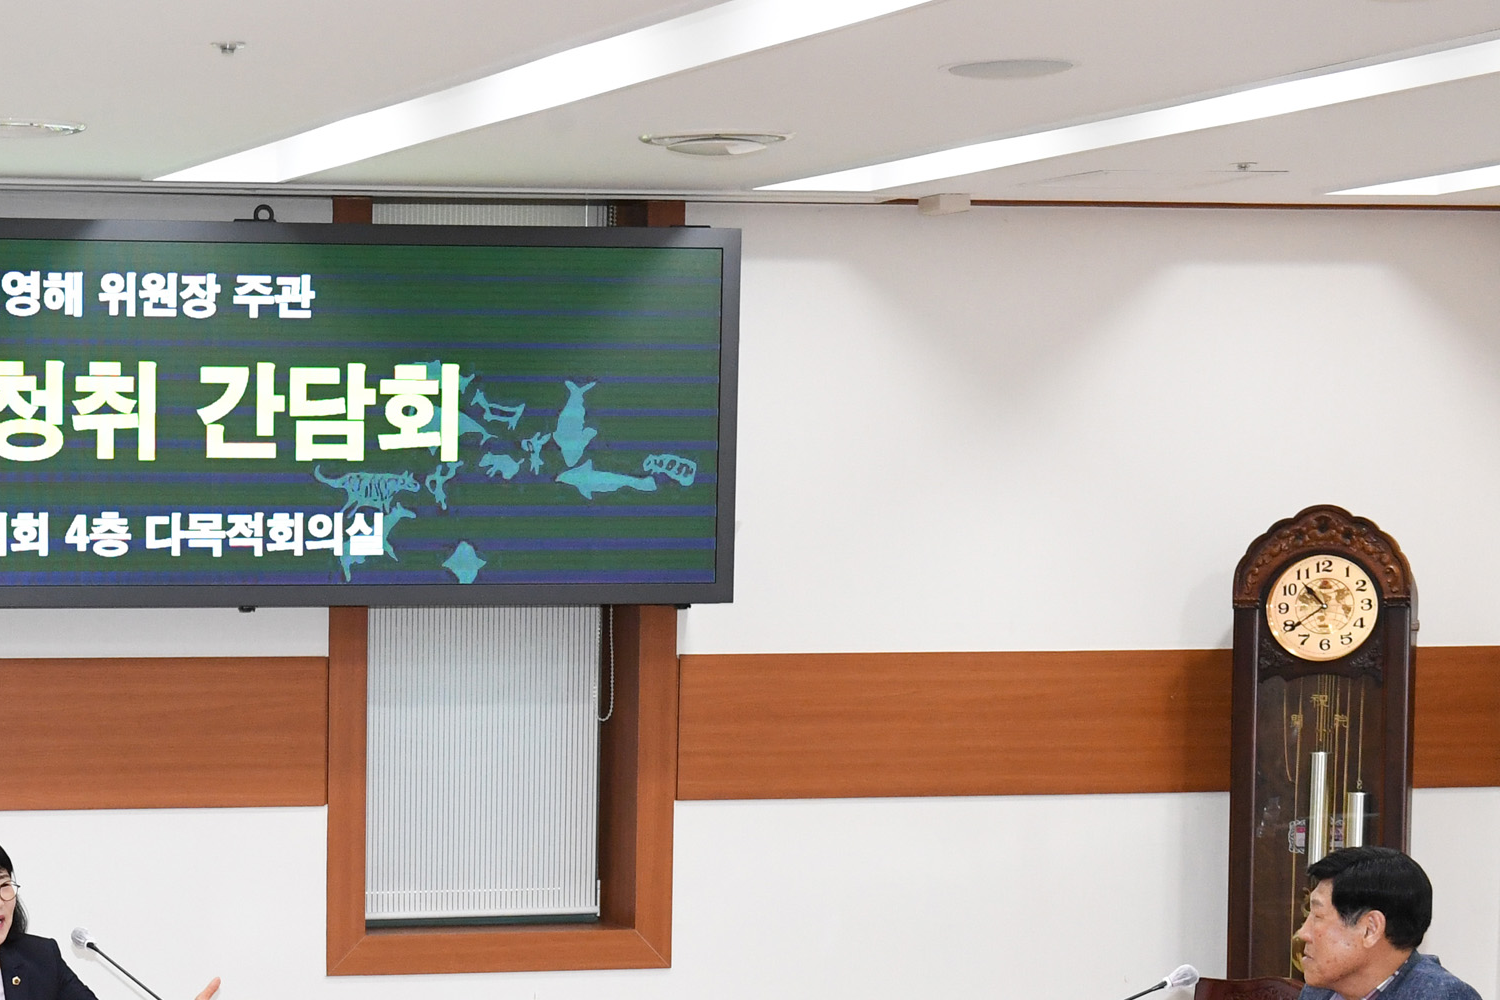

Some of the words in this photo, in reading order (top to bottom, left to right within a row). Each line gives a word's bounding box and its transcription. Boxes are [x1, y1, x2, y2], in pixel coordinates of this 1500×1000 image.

[99, 271, 221, 319] 위원장
[233, 274, 315, 319] 주관
[196, 362, 460, 462] 간담회
[64, 511, 132, 558] 4층
[145, 511, 384, 558] 다목적회의실
[1316, 560, 1333, 573] 12
[1345, 566, 1350, 577] 1
[1296, 567, 1310, 580] 11
[1283, 583, 1297, 596] 10
[1355, 580, 1367, 592] 2
[1278, 602, 1289, 614] 9
[1360, 598, 1373, 611] 3
[1283, 619, 1296, 632] 8
[1353, 617, 1365, 629] 4
[1298, 634, 1310, 646] 7
[1319, 639, 1331, 651] 6
[1340, 632, 1353, 645] 5
